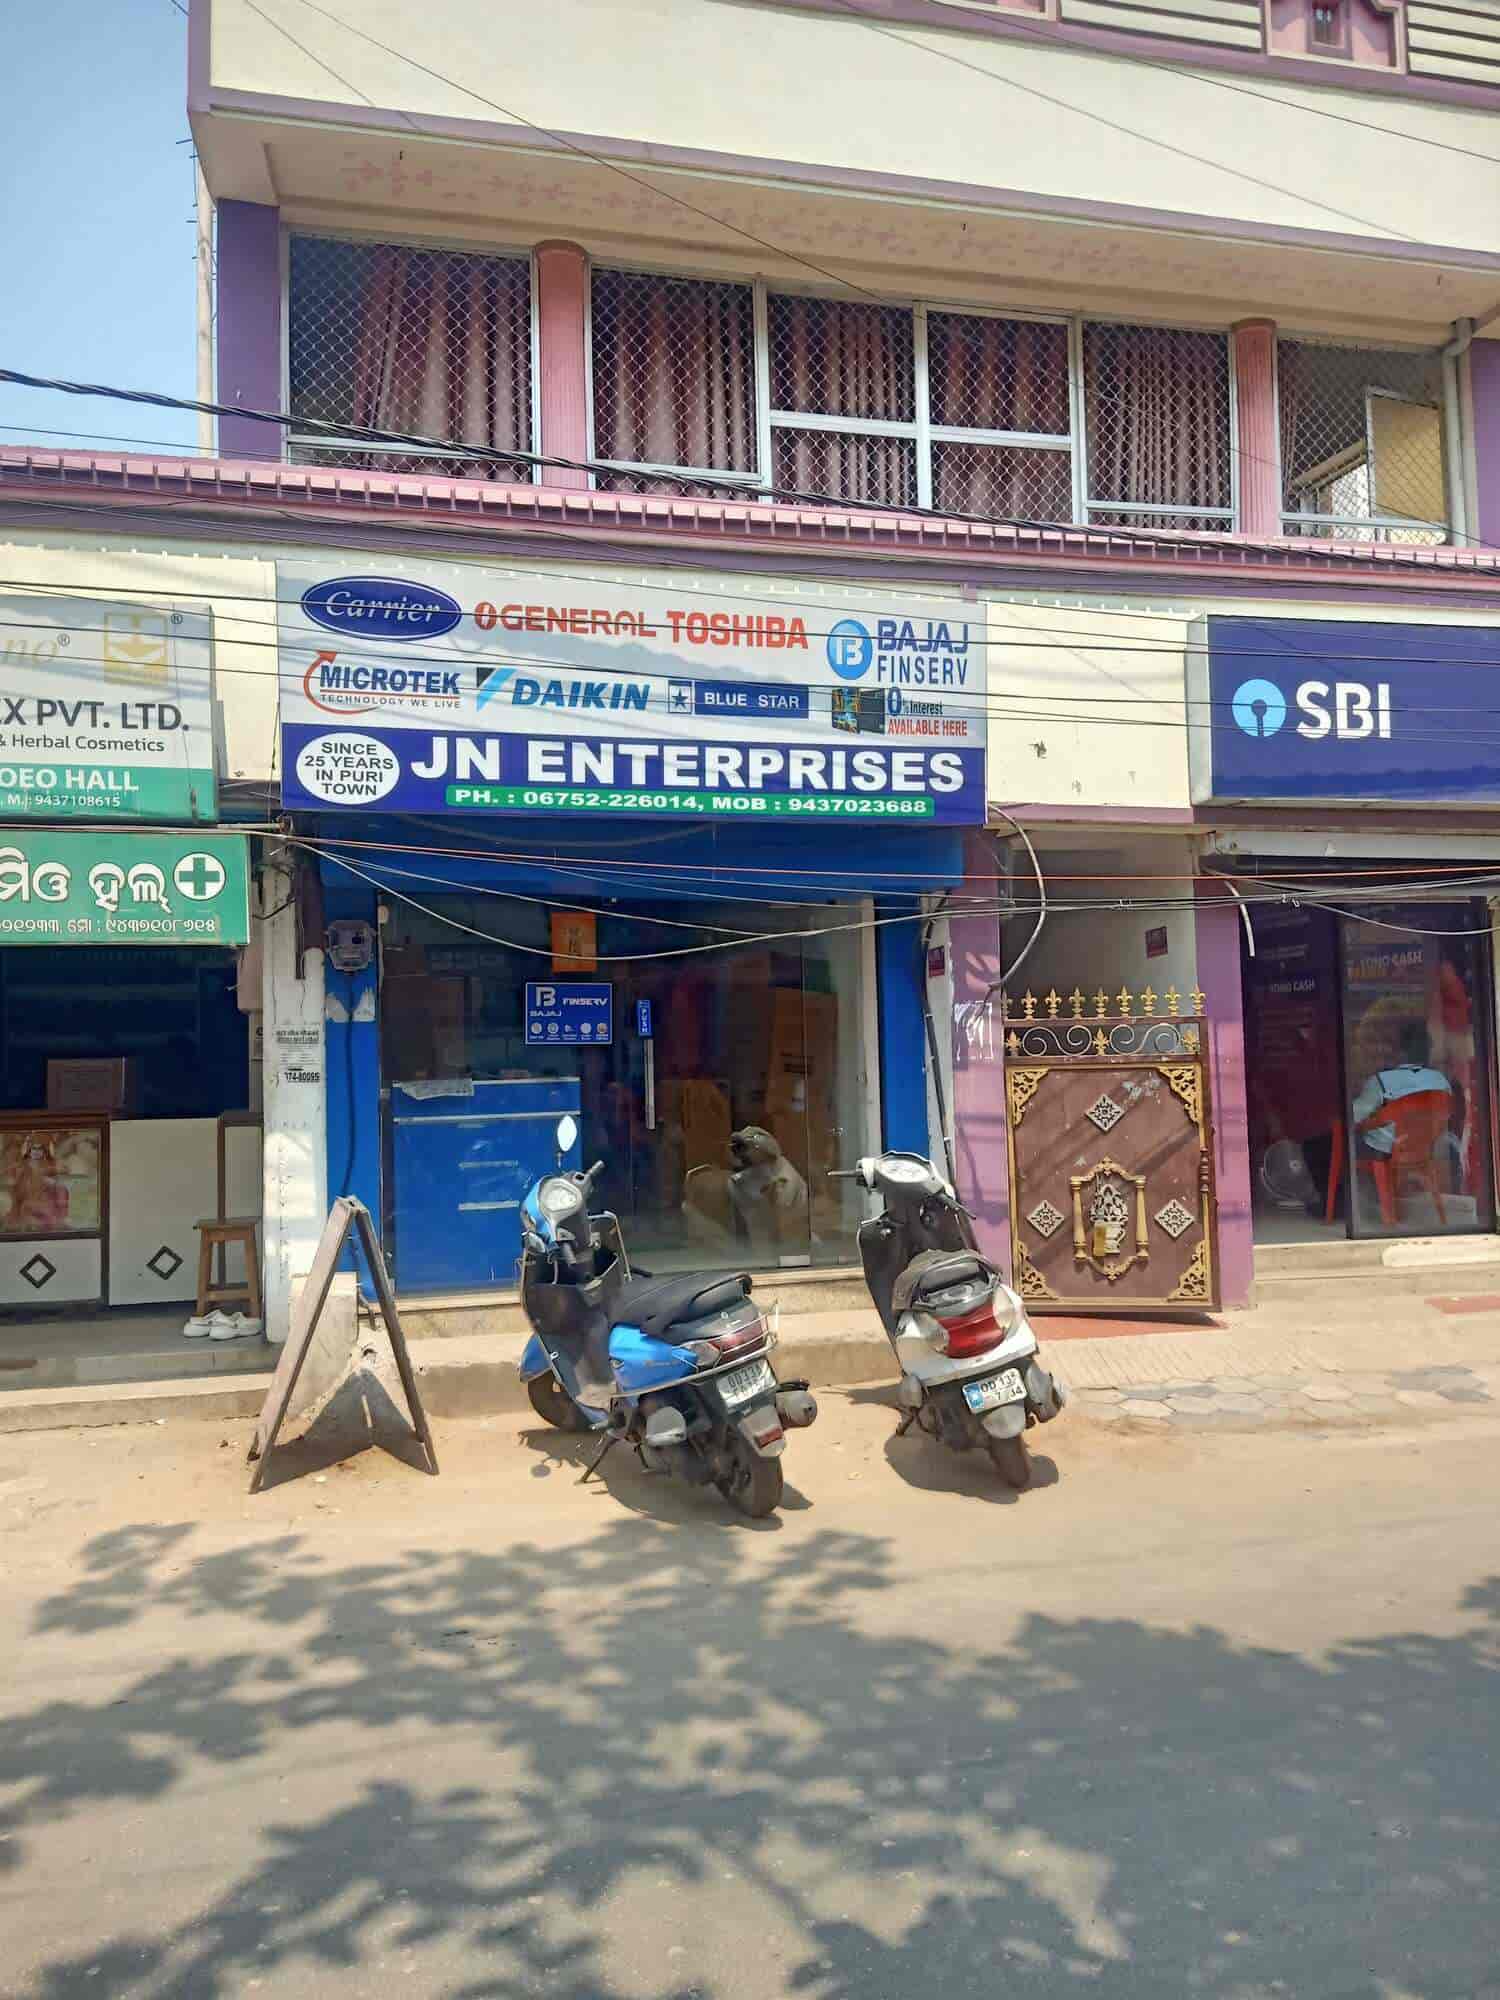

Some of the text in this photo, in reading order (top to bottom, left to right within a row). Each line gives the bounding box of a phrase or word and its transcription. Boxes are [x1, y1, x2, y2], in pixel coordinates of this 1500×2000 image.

[325, 591, 441, 622] Carrier
[667, 611, 809, 650] TOSHIBA
[877, 619, 969, 654] BAJAJ
[319, 664, 462, 695] MICROTEK
[877, 655, 969, 685] FINSERV
[320, 694, 462, 709] TECHNOLOGY WE LIVE
[511, 679, 651, 711] DAIKIN
[704, 691, 799, 709] BLUE STAR
[0, 698, 190, 731] X PVT. LTD.
[1295, 680, 1392, 740] SBI
[887, 719, 967, 736] AVAILABLE HERE
[12, 734, 70, 749] Herbal
[75, 736, 165, 752] Cosmetics
[321, 742, 377, 755] SINCE
[305, 756, 394, 769] 25 YEARS
[411, 736, 965, 793] JN ENTERPRISES
[0, 767, 139, 791] OEO HALL
[316, 769, 383, 782] IN PURI
[322, 783, 377, 795] TOWN
[36, 795, 121, 807] 9437108615
[523, 791, 705, 812] 06752-226014,
[712, 796, 767, 810] MOB
[789, 799, 927, 814] 9437023688
